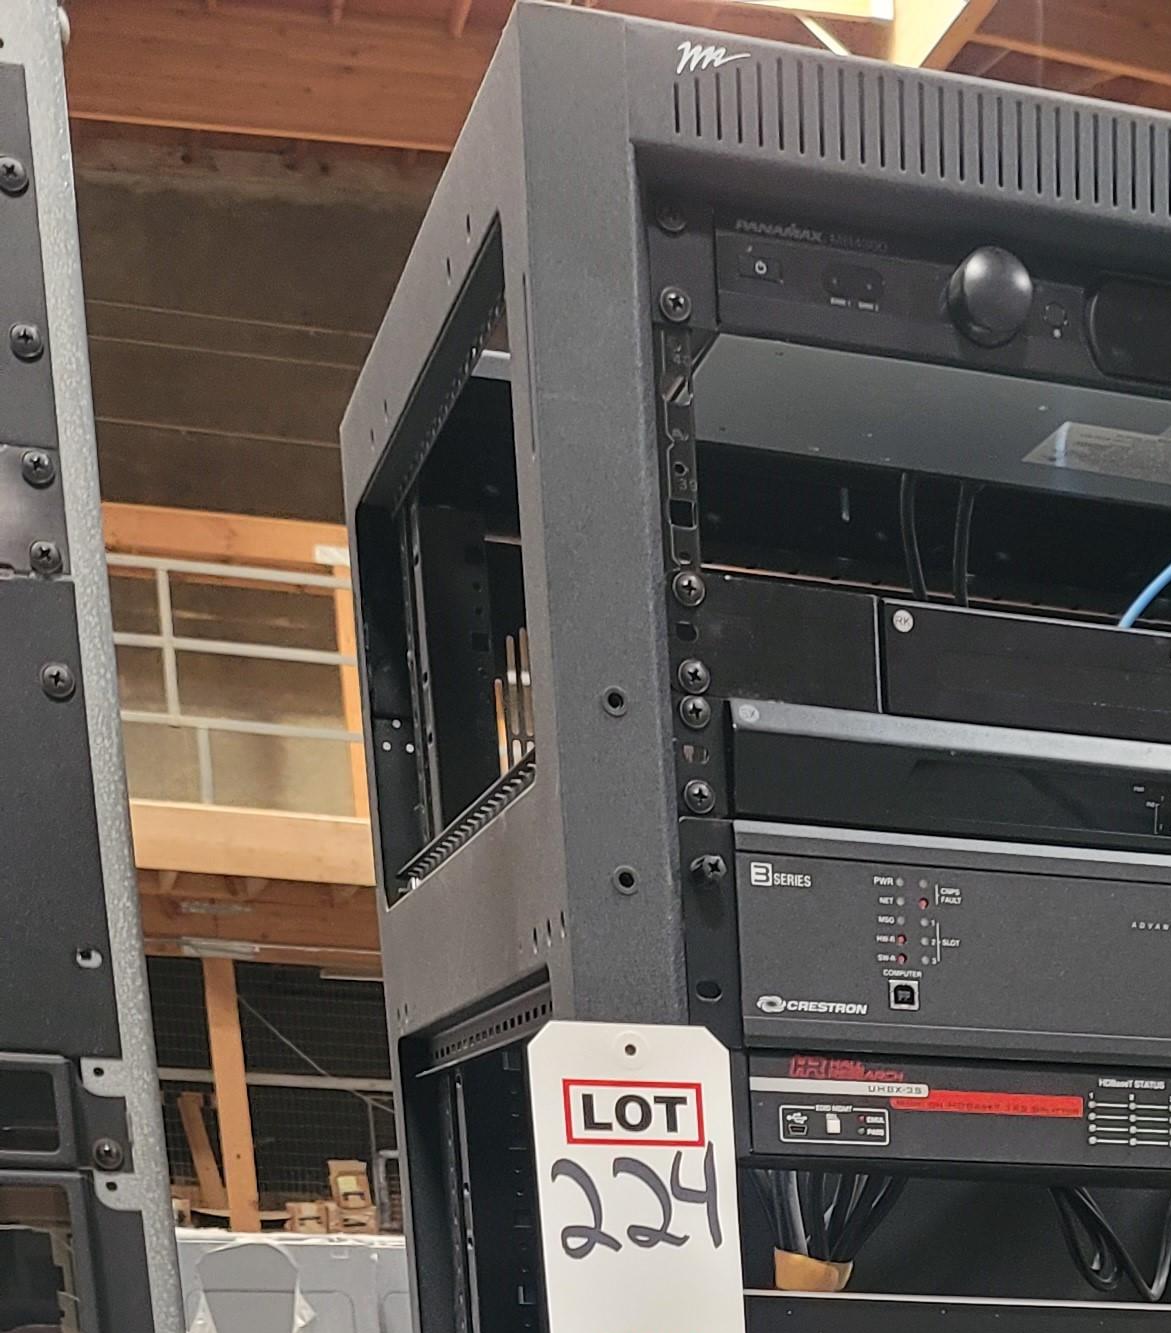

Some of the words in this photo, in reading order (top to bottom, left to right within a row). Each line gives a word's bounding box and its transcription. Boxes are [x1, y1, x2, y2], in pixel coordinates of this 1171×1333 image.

[773, 874, 812, 888] SERIES
[873, 876, 894, 886] PWR
[879, 896, 894, 905] NET
[940, 896, 962, 905] FAULT
[878, 915, 895, 924] MSG
[941, 938, 960, 948] SLOT
[882, 968, 923, 979] COMPUTER
[786, 1000, 868, 1015] CRESTRON
[581, 1092, 688, 1133] LOT
[551, 1140, 723, 1259] 224
